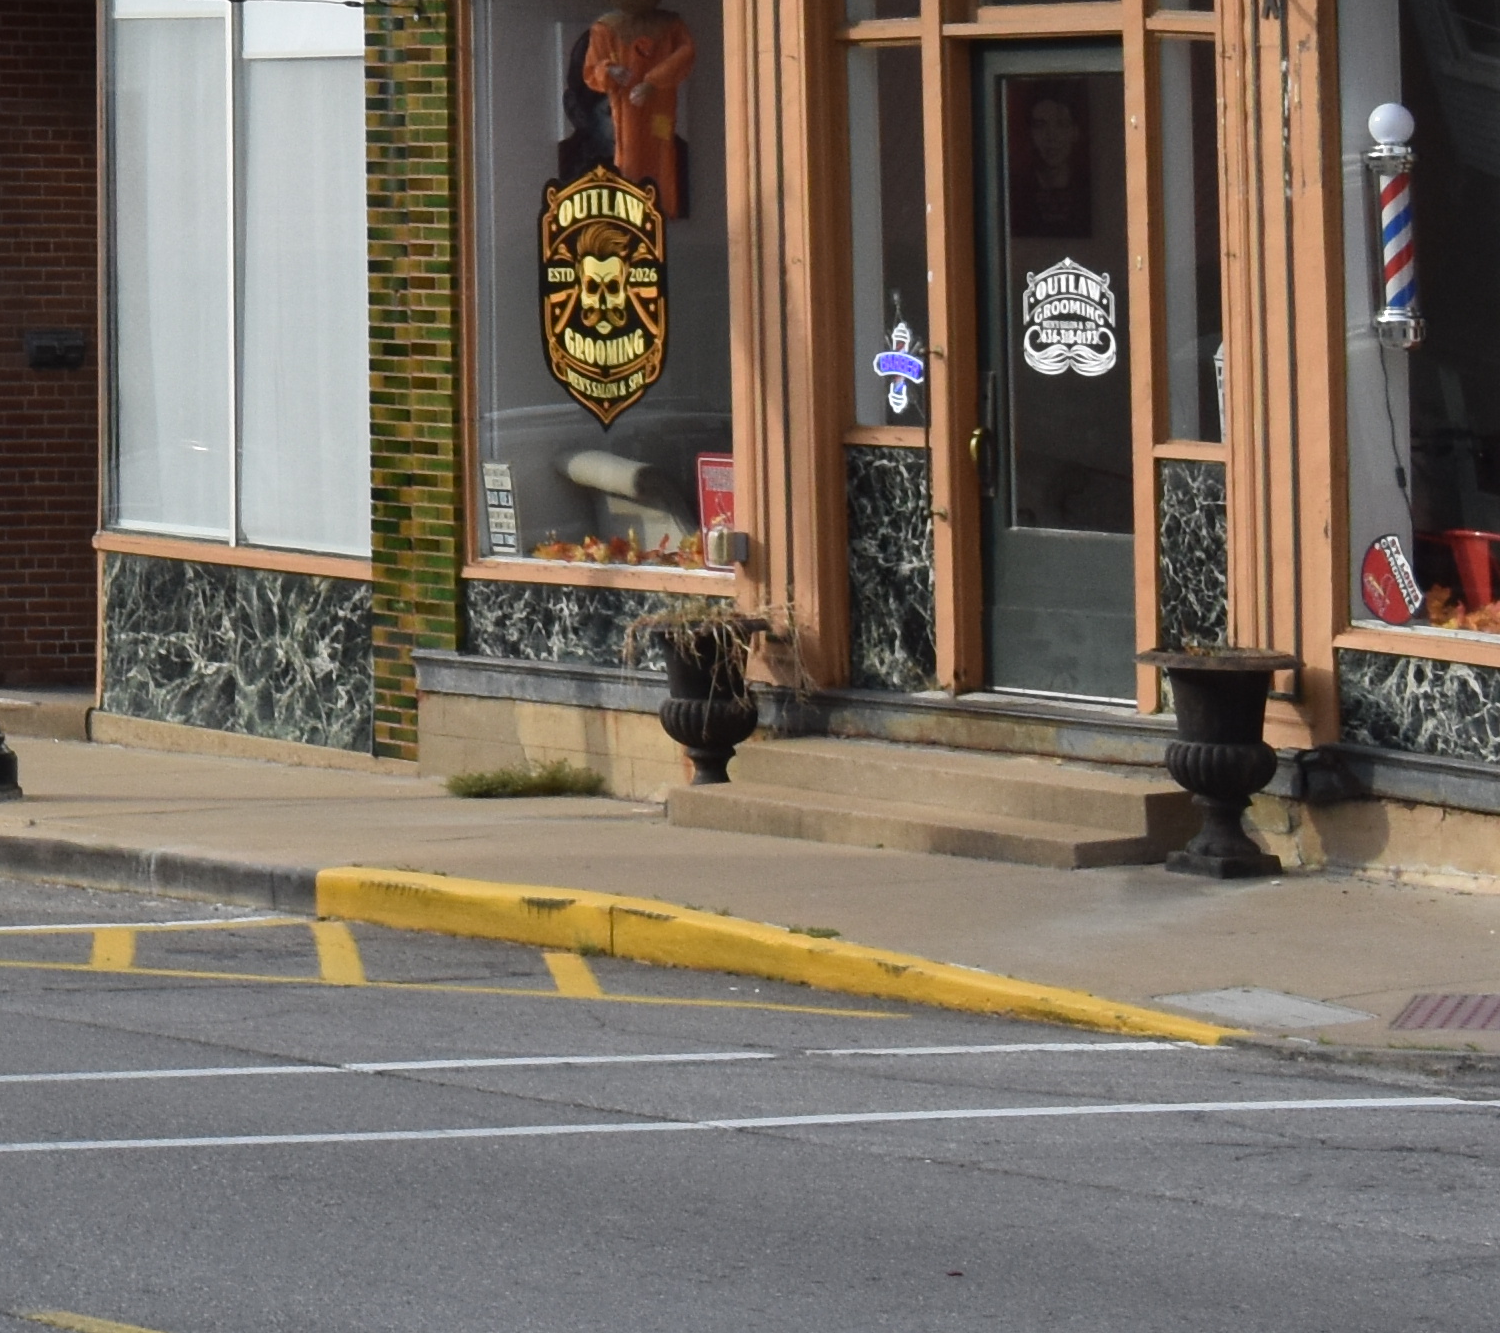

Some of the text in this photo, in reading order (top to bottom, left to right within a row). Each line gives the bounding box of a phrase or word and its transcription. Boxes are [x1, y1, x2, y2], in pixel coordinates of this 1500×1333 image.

[558, 188, 645, 229] OUTLAW
[547, 267, 658, 282] ESTD 2026
[1035, 274, 1101, 302] OUTLAW
[1034, 299, 1104, 325] GROOMING
[564, 328, 645, 366] GROOMING
[591, 381, 619, 399] SALON
[628, 370, 646, 393] SPA
[1381, 538, 1415, 614] CARDINALS
